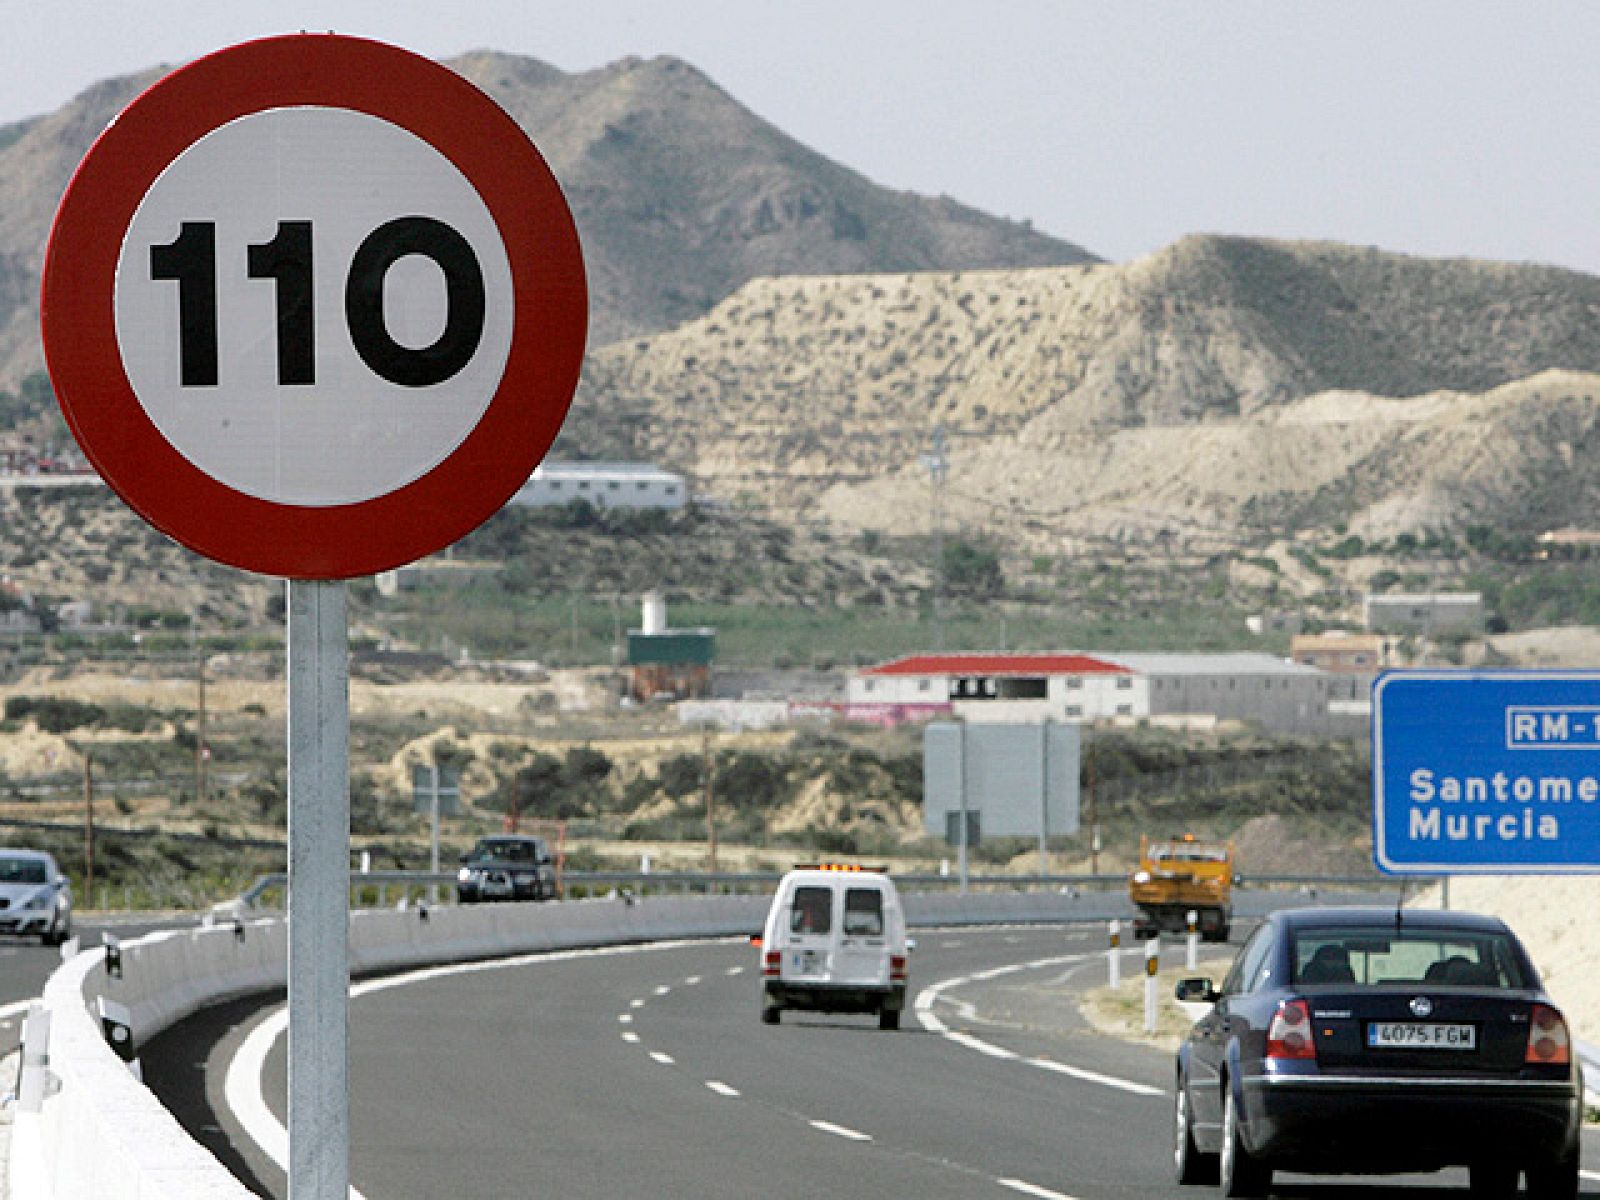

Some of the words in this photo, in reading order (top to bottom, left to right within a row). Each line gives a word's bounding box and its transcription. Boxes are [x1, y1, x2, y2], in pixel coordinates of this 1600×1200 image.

[150, 215, 486, 388] 110
[1409, 768, 1600, 803] Santome
[1409, 807, 1559, 841] Murcia
[1381, 1023, 1430, 1043] 4075
